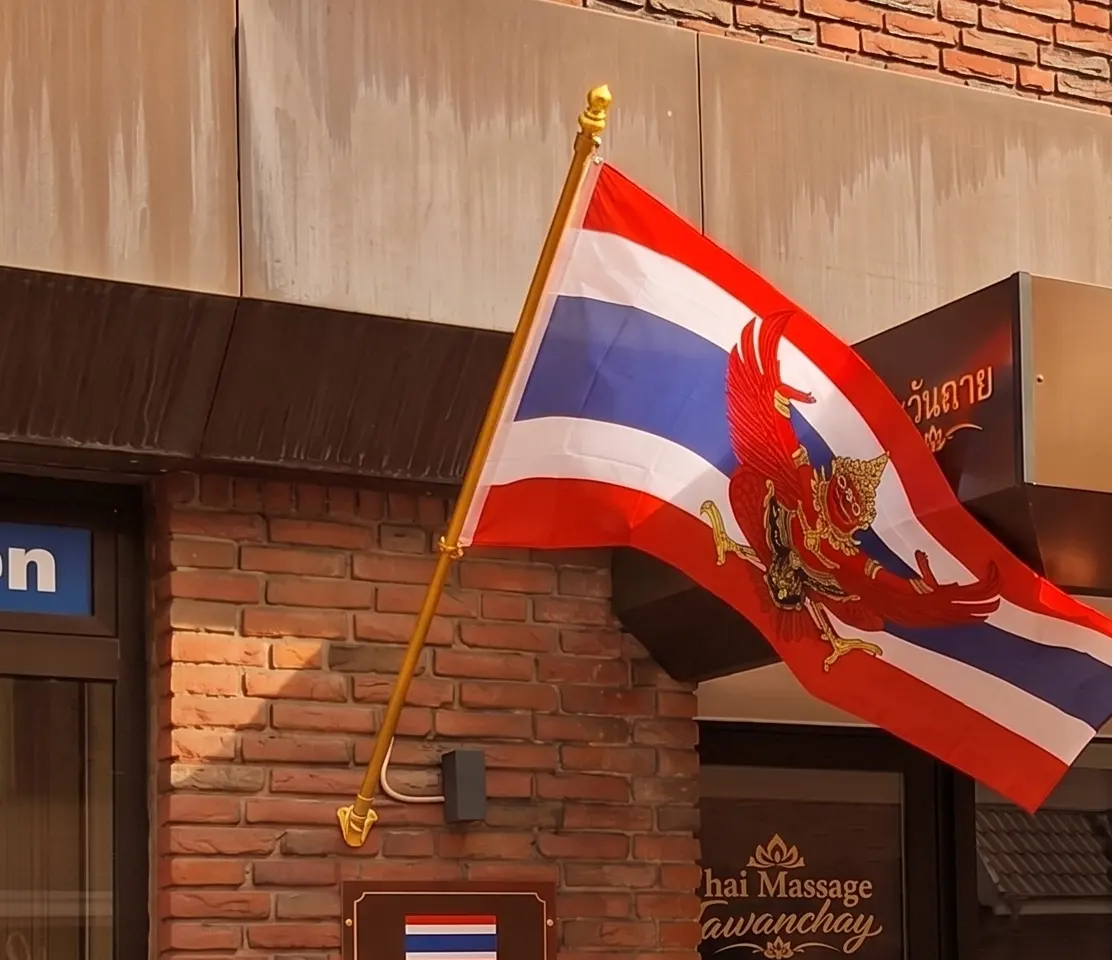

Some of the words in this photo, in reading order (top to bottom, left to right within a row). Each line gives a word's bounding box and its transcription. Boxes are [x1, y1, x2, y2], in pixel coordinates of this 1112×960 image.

[0, 547, 57, 593] n
[702, 867, 749, 898] hai
[757, 870, 874, 908] Massage
